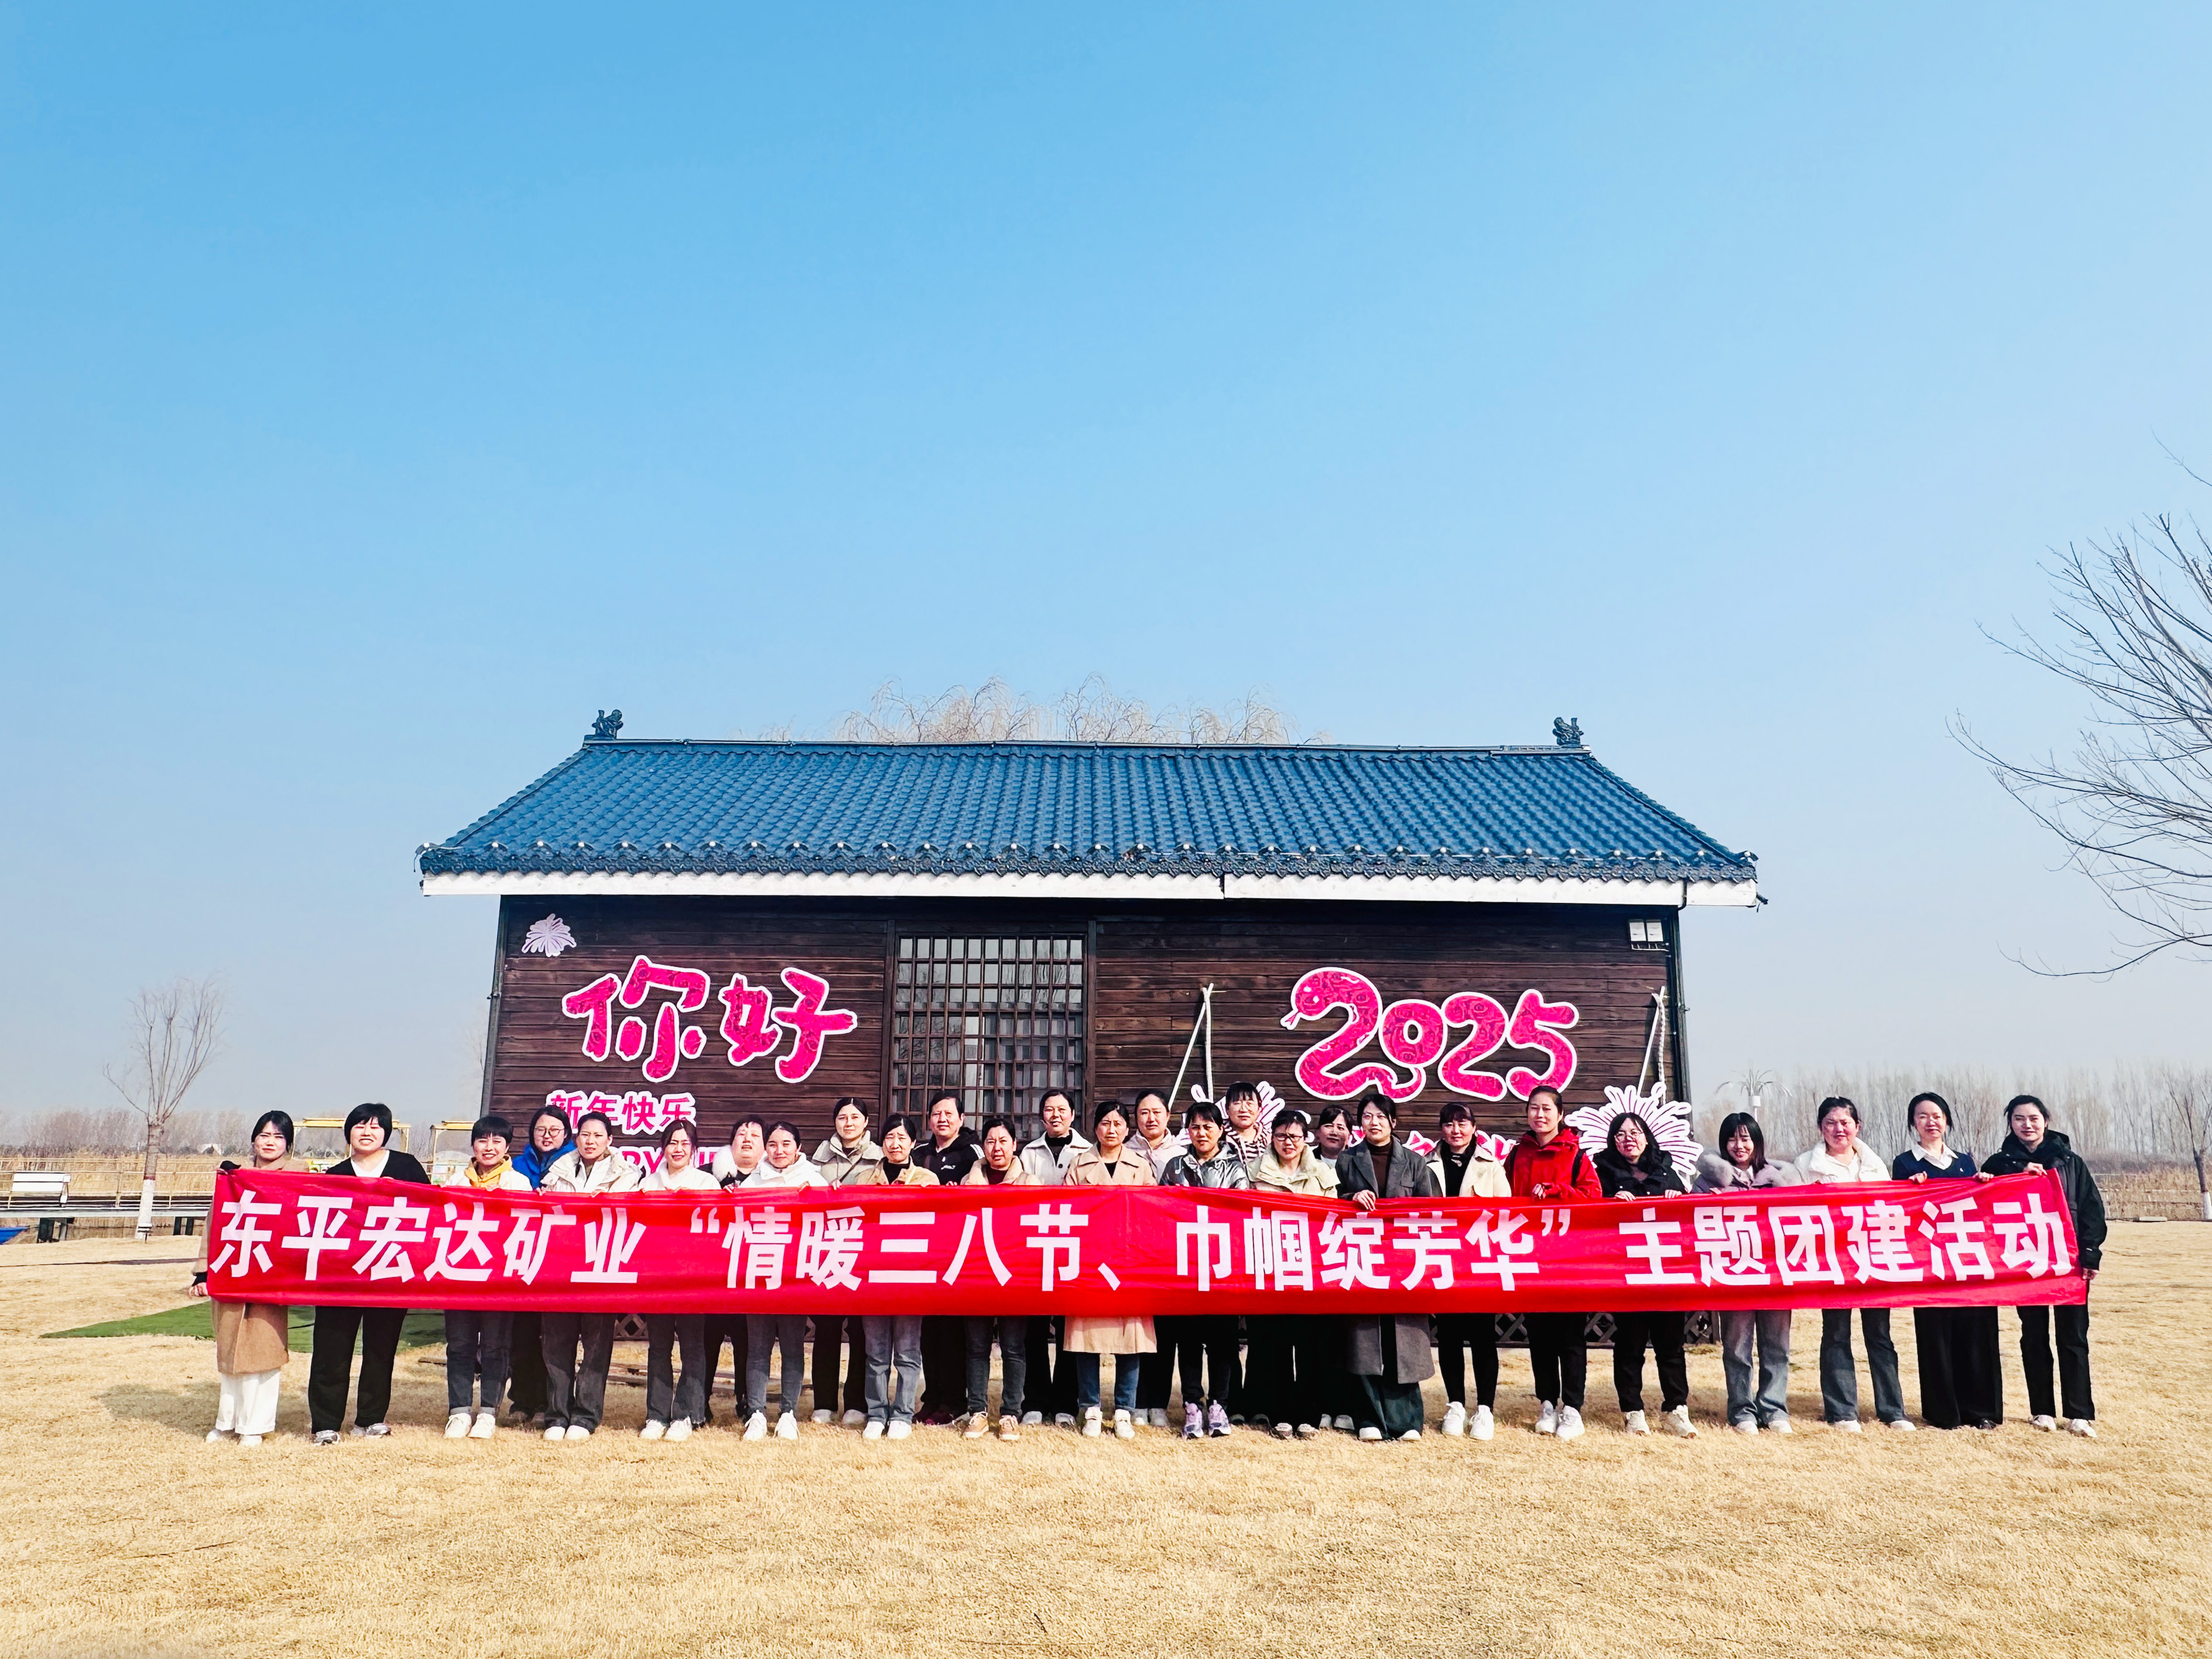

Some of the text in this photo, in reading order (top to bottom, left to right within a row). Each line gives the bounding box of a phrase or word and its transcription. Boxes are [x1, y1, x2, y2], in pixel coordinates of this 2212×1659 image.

[562, 955, 857, 1083] 你好
[1280, 967, 1579, 1103] 2025
[210, 1189, 646, 1285] 东平宏达矿业
[1618, 1192, 2074, 1288] 主题团建活动
